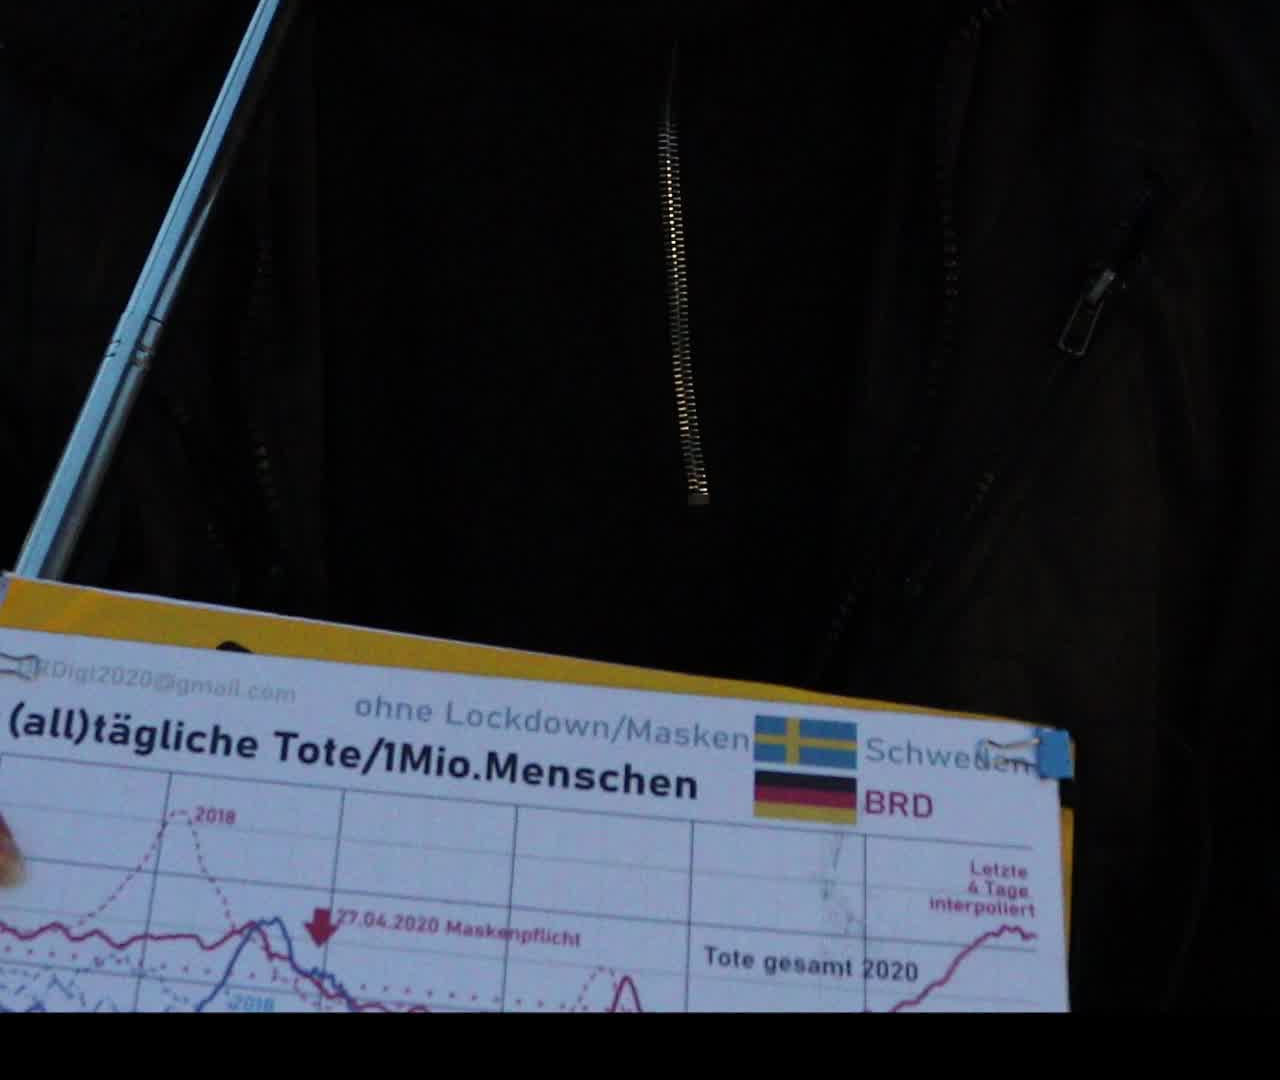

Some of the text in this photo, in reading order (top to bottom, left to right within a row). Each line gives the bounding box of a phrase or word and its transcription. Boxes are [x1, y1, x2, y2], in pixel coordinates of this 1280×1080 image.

[355, 696, 750, 751] ohne Lockdown/Masken
[8, 702, 698, 800] (all)tägliche Tote/1Mio.Menschen
[195, 806, 237, 824] 2018
[865, 789, 933, 818] BRD
[971, 860, 1028, 879] Letzte
[968, 881, 1029, 900] 4 Tage
[930, 896, 1036, 919] interpoliert
[336, 909, 582, 948] 27.04.2020 Maskenpflicht
[705, 945, 919, 982] Tote gesamt 2020
